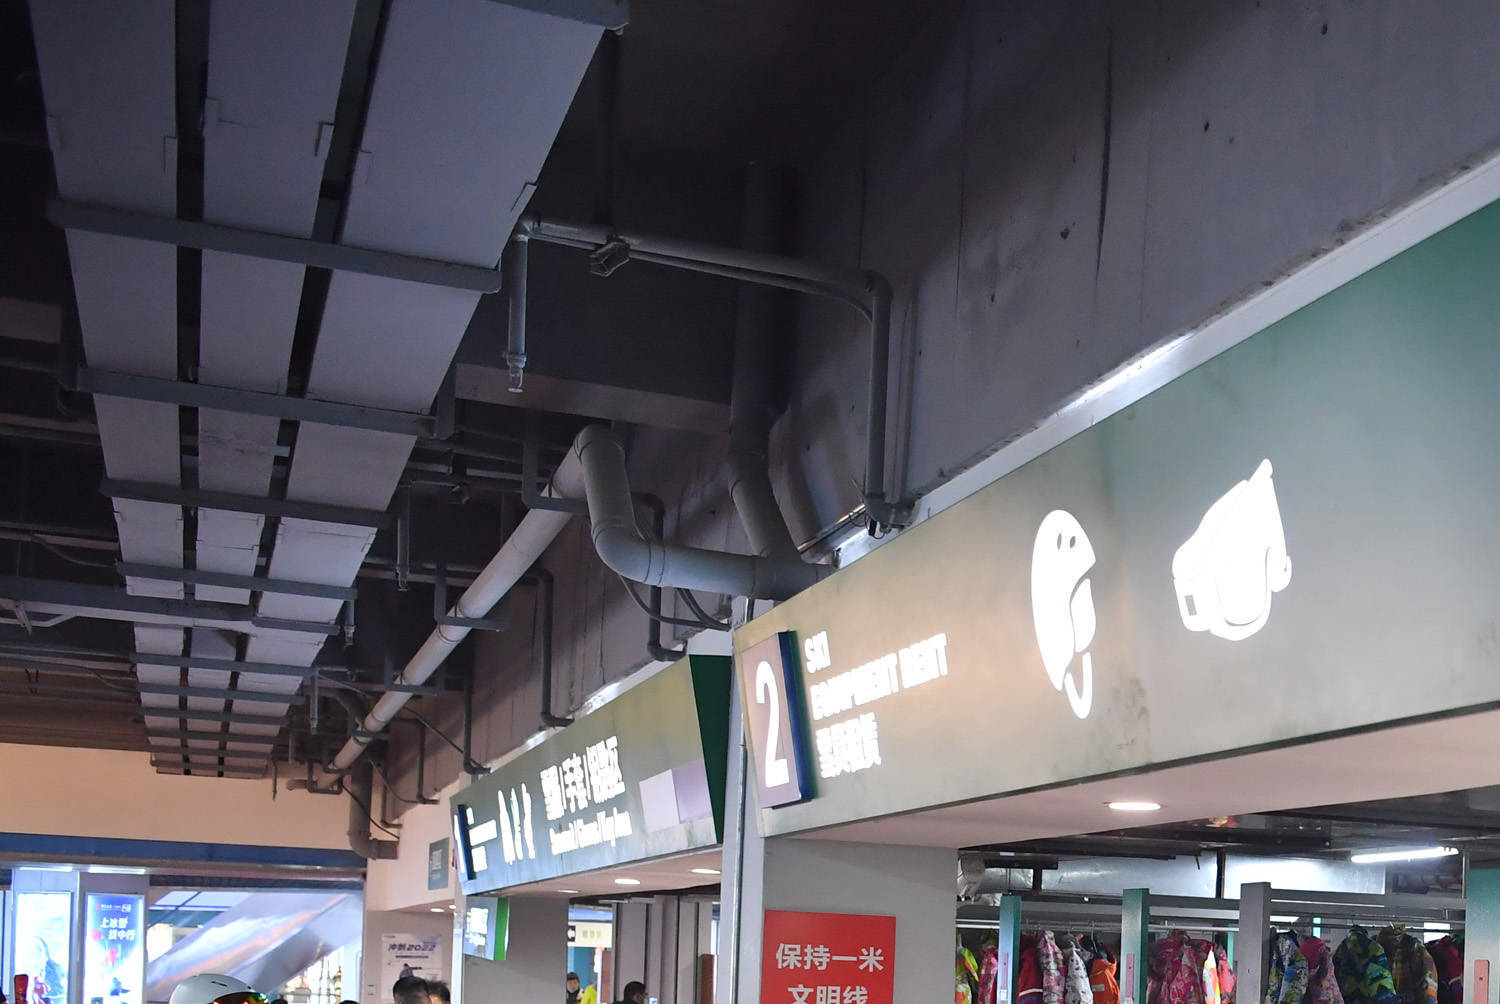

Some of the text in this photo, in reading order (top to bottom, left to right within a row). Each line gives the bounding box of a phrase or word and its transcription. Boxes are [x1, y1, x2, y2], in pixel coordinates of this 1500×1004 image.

[755, 660, 790, 789] 2
[776, 943, 884, 973] 保持一米
